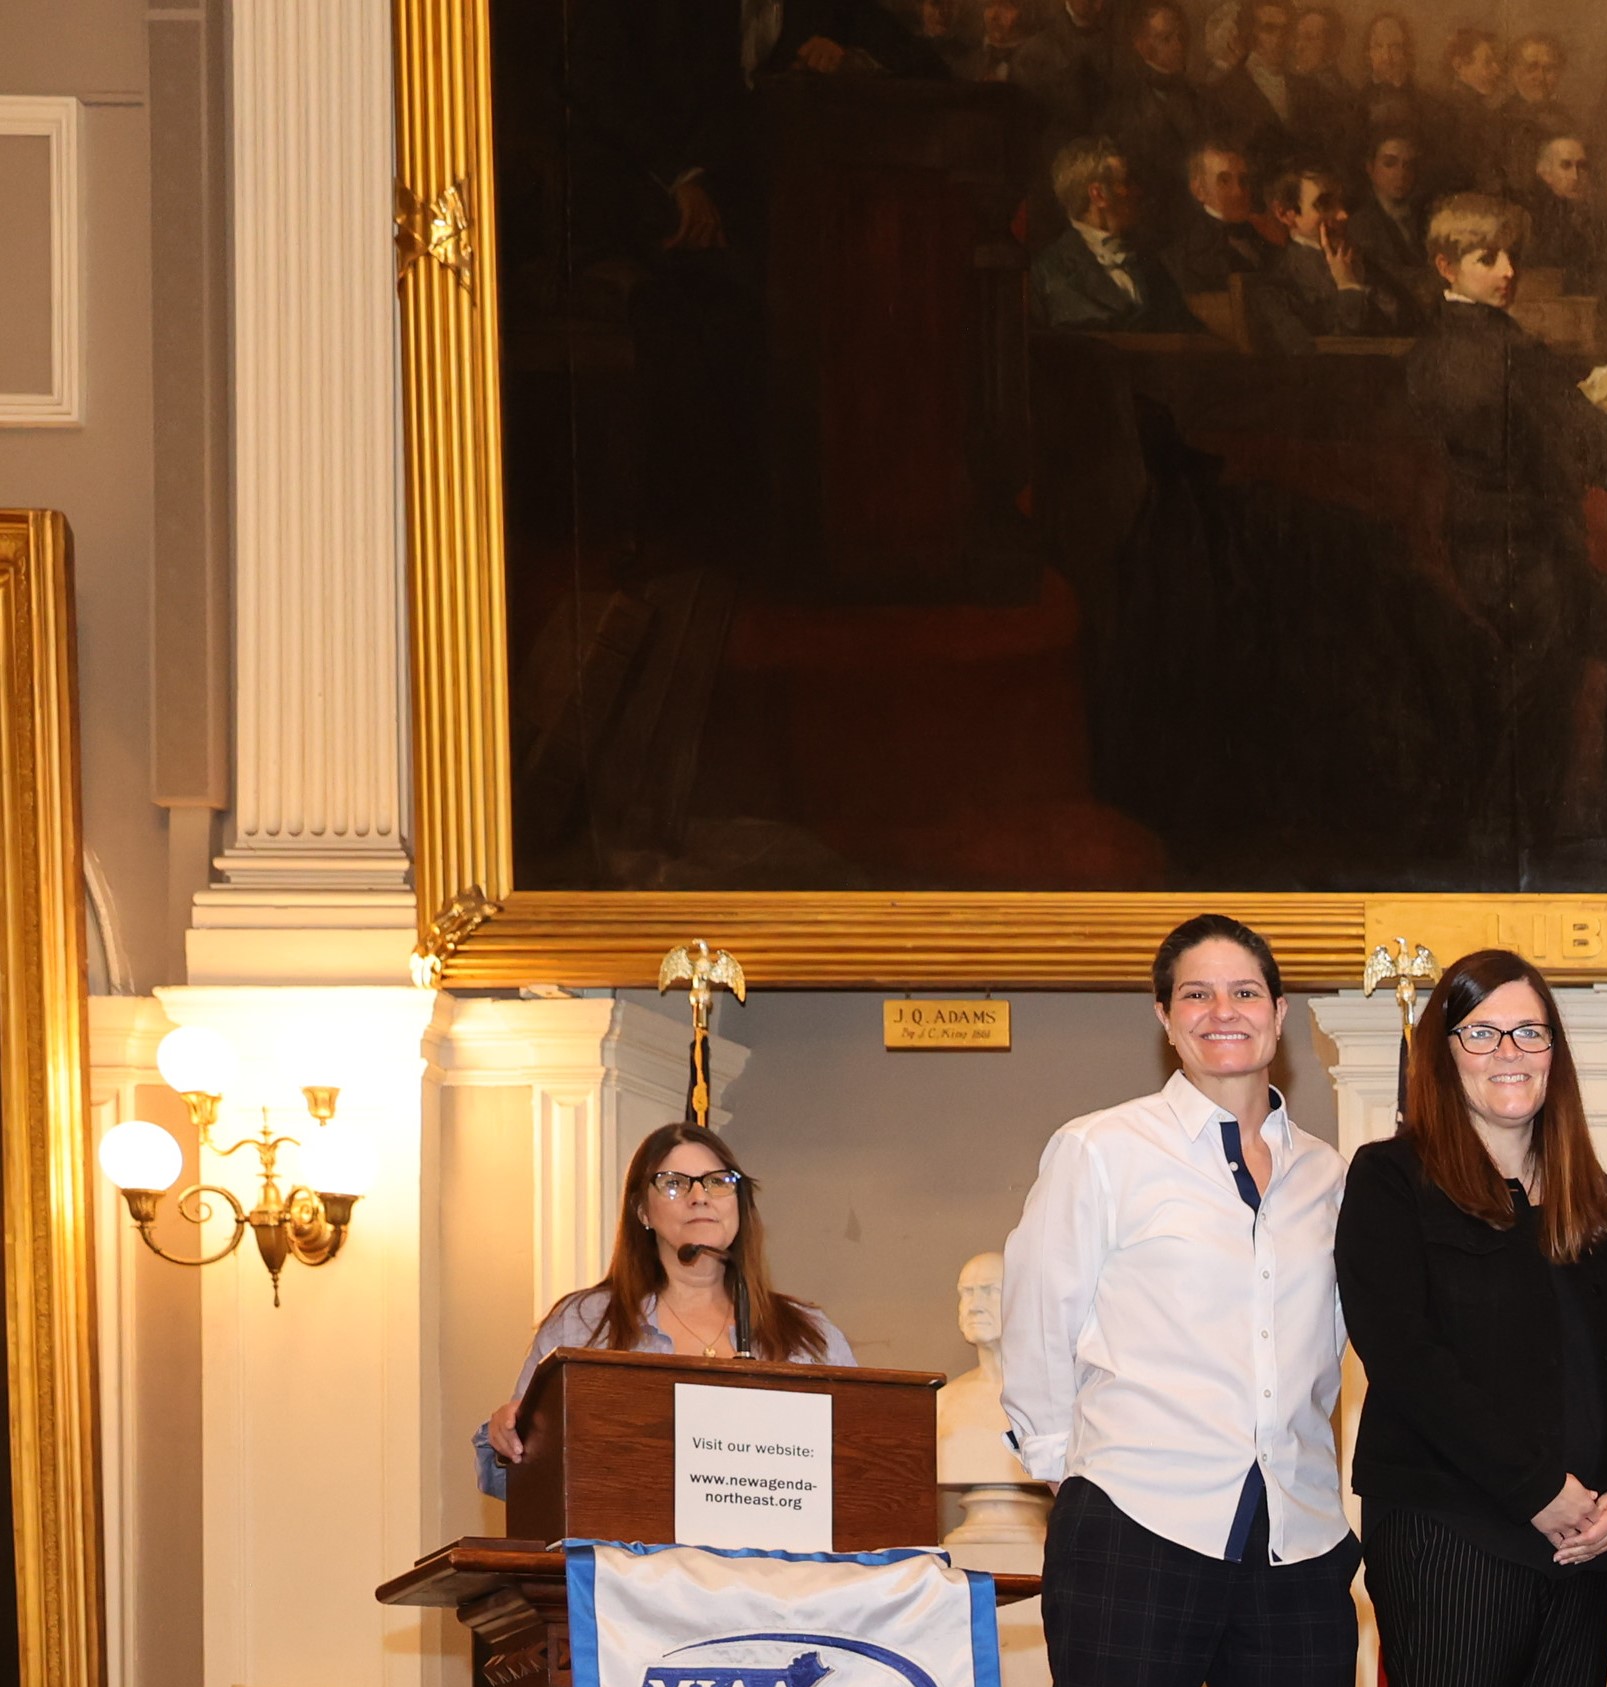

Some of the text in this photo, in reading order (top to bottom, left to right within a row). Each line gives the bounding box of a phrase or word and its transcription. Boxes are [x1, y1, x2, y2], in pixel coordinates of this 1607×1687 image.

[935, 1009, 996, 1024] ADAMS
[692, 1437, 815, 1458] Visit our website:
[690, 1473, 817, 1491] www.newagenda-
[705, 1492, 802, 1511] northeast.org
